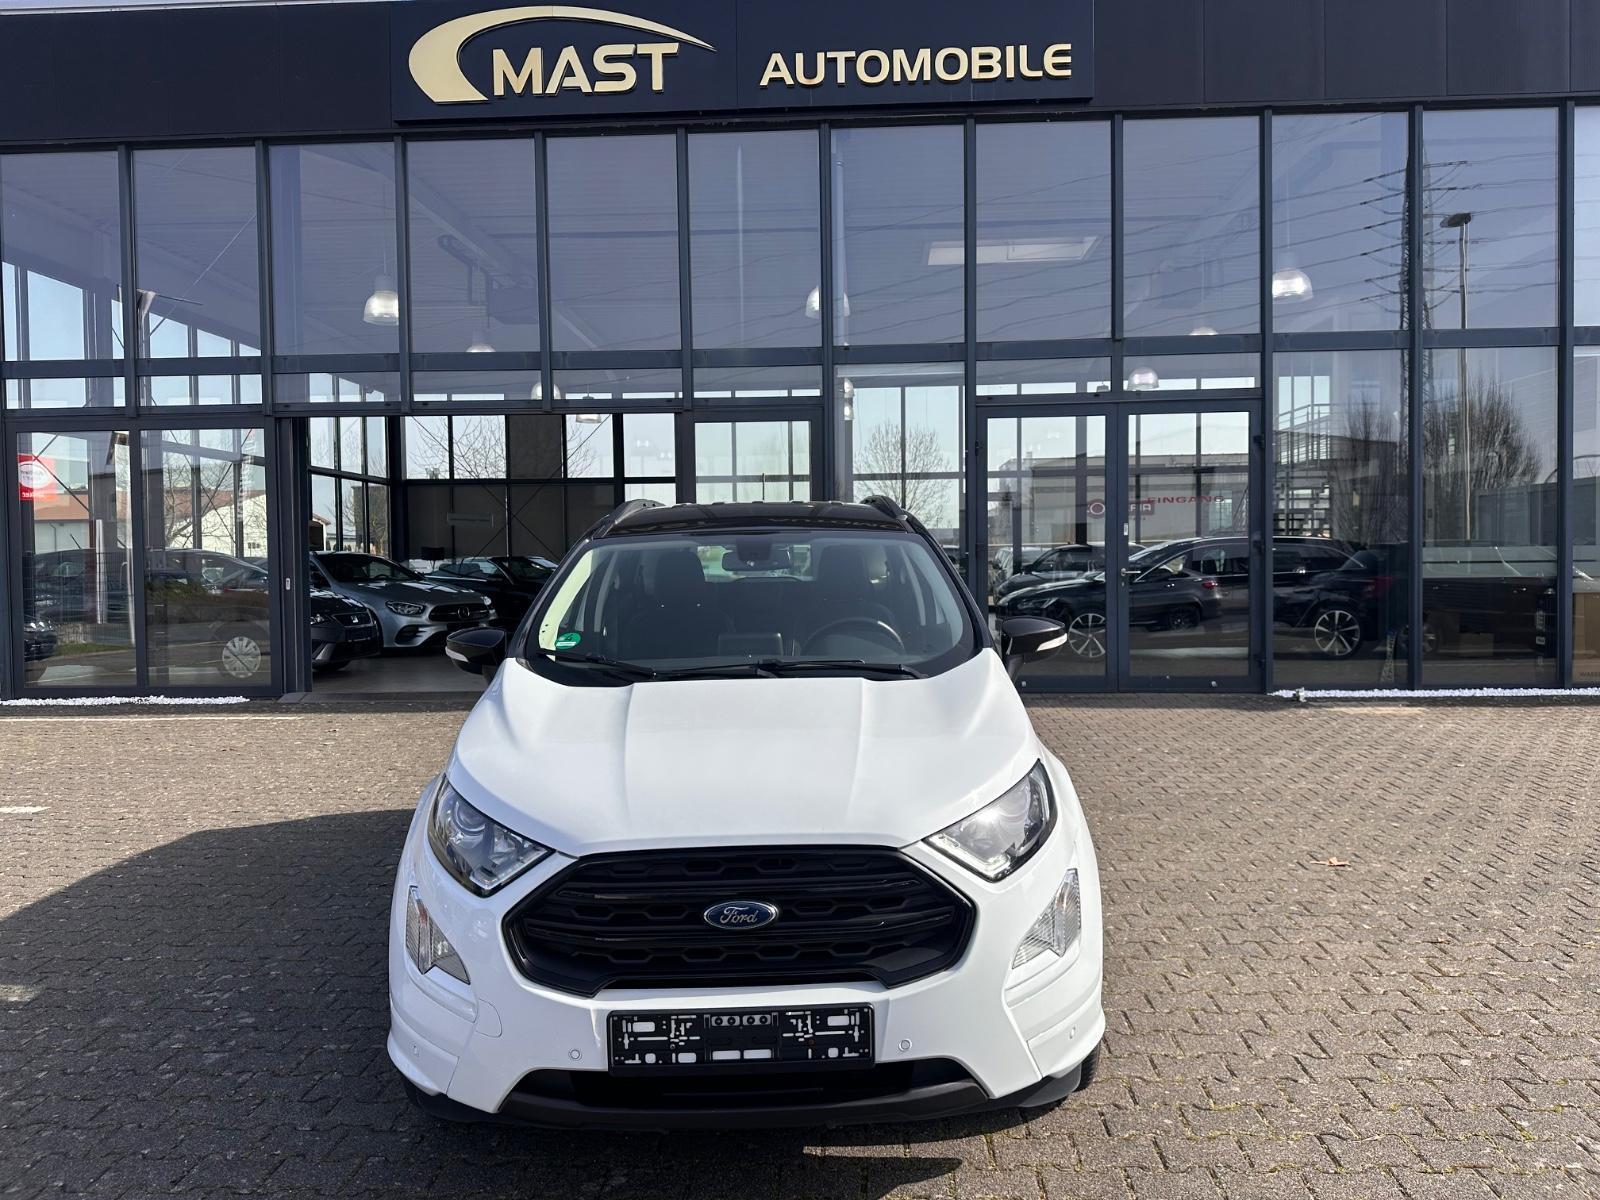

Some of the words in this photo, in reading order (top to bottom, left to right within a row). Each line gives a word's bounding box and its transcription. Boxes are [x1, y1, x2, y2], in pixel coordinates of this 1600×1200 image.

[493, 43, 680, 97] MAST
[759, 43, 1073, 87] AUTOMOBILE
[720, 906, 759, 924] Ford
